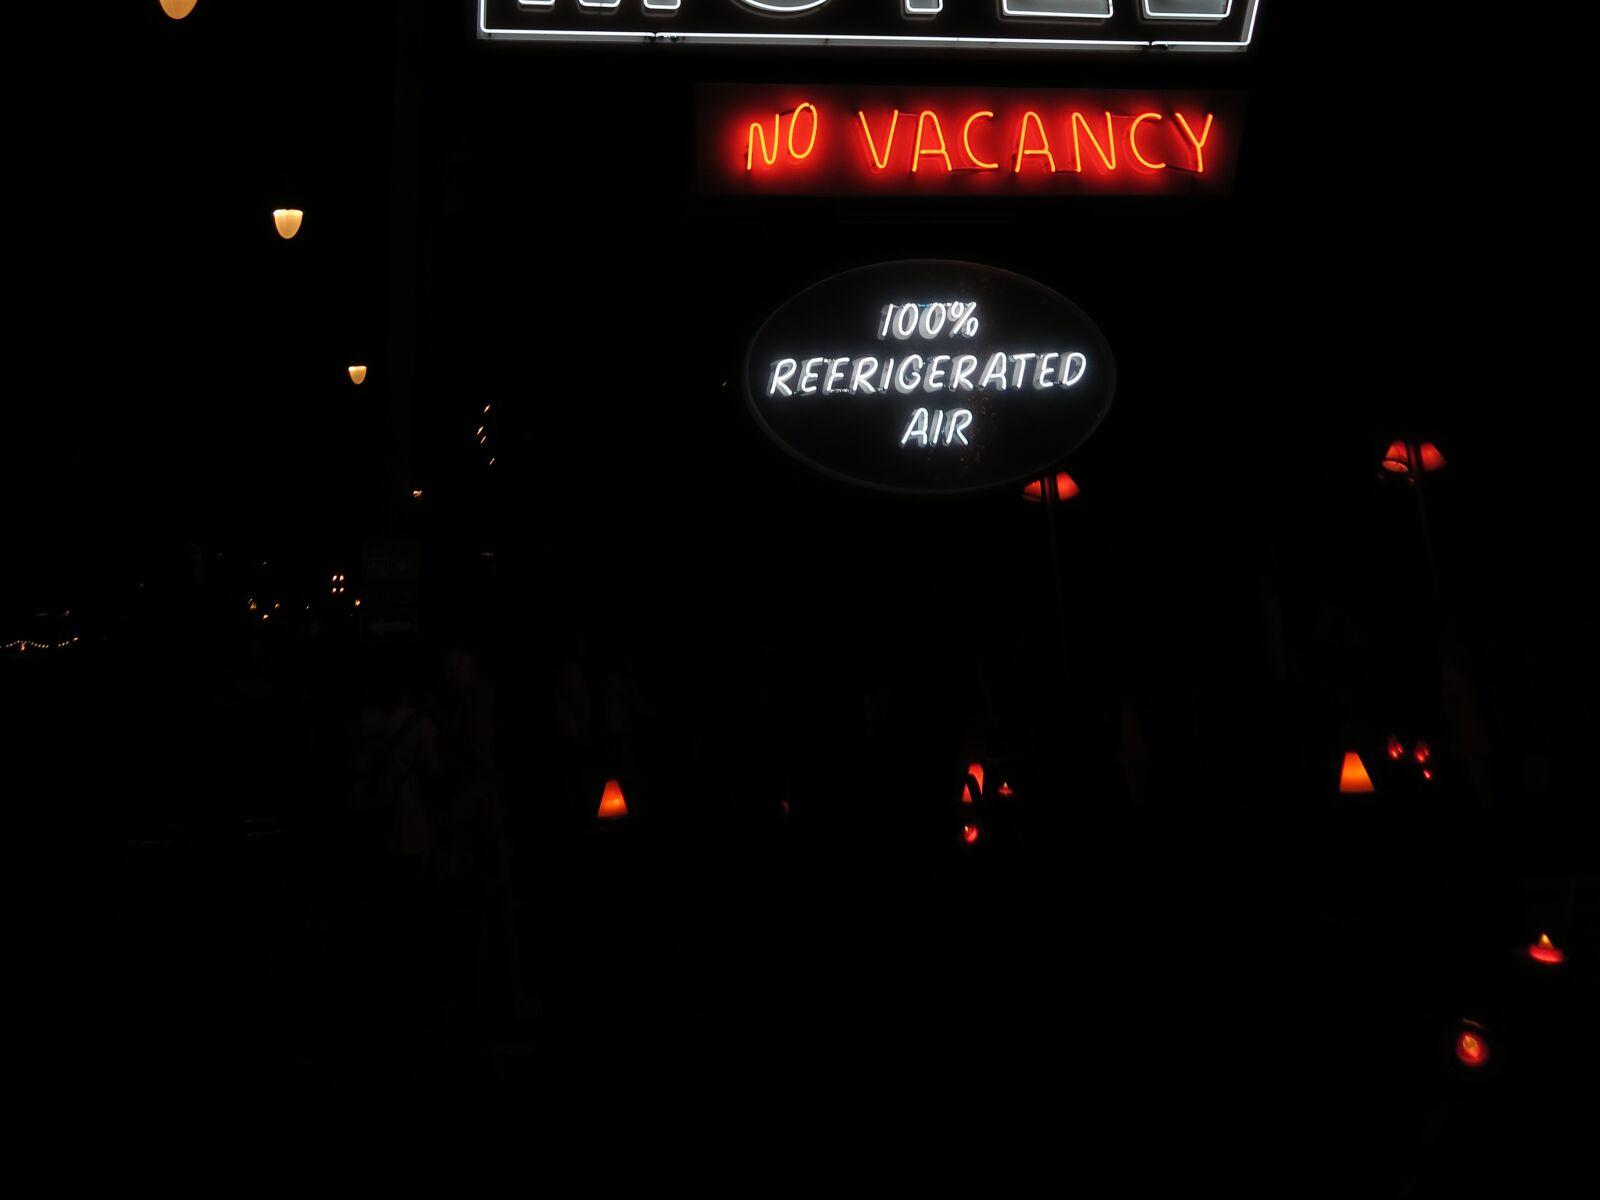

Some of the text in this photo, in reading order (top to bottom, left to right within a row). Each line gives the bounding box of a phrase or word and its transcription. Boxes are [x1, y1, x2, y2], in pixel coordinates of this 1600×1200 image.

[745, 102, 1215, 173] NO VACANCY
[880, 301, 980, 338] 100%
[769, 351, 1088, 397] REFRIGERATED
[901, 407, 973, 445] AIR
